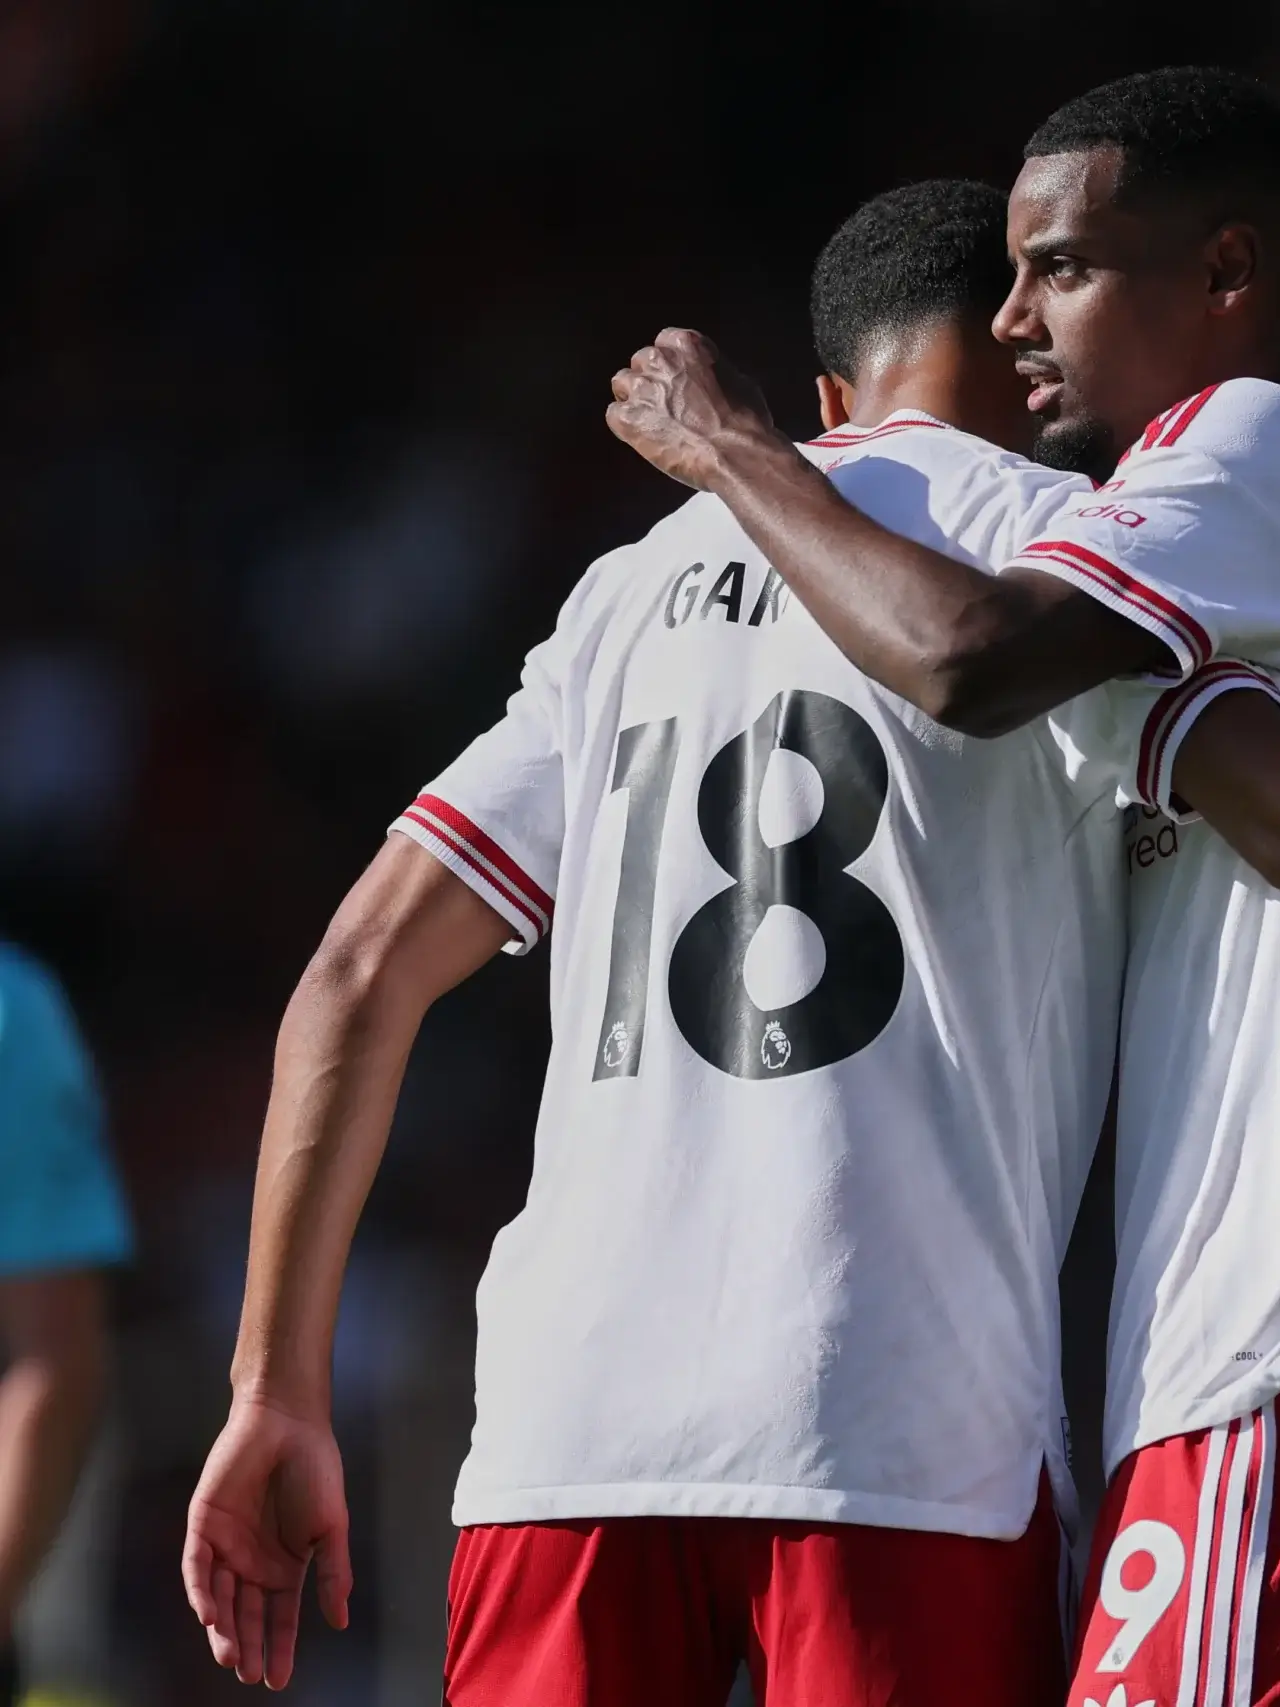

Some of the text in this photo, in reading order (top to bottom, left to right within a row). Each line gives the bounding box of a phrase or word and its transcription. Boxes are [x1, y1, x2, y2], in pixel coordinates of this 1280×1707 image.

[663, 561, 790, 629] GAK
[592, 689, 905, 1081] 18
[1094, 1519, 1186, 1673] 9
